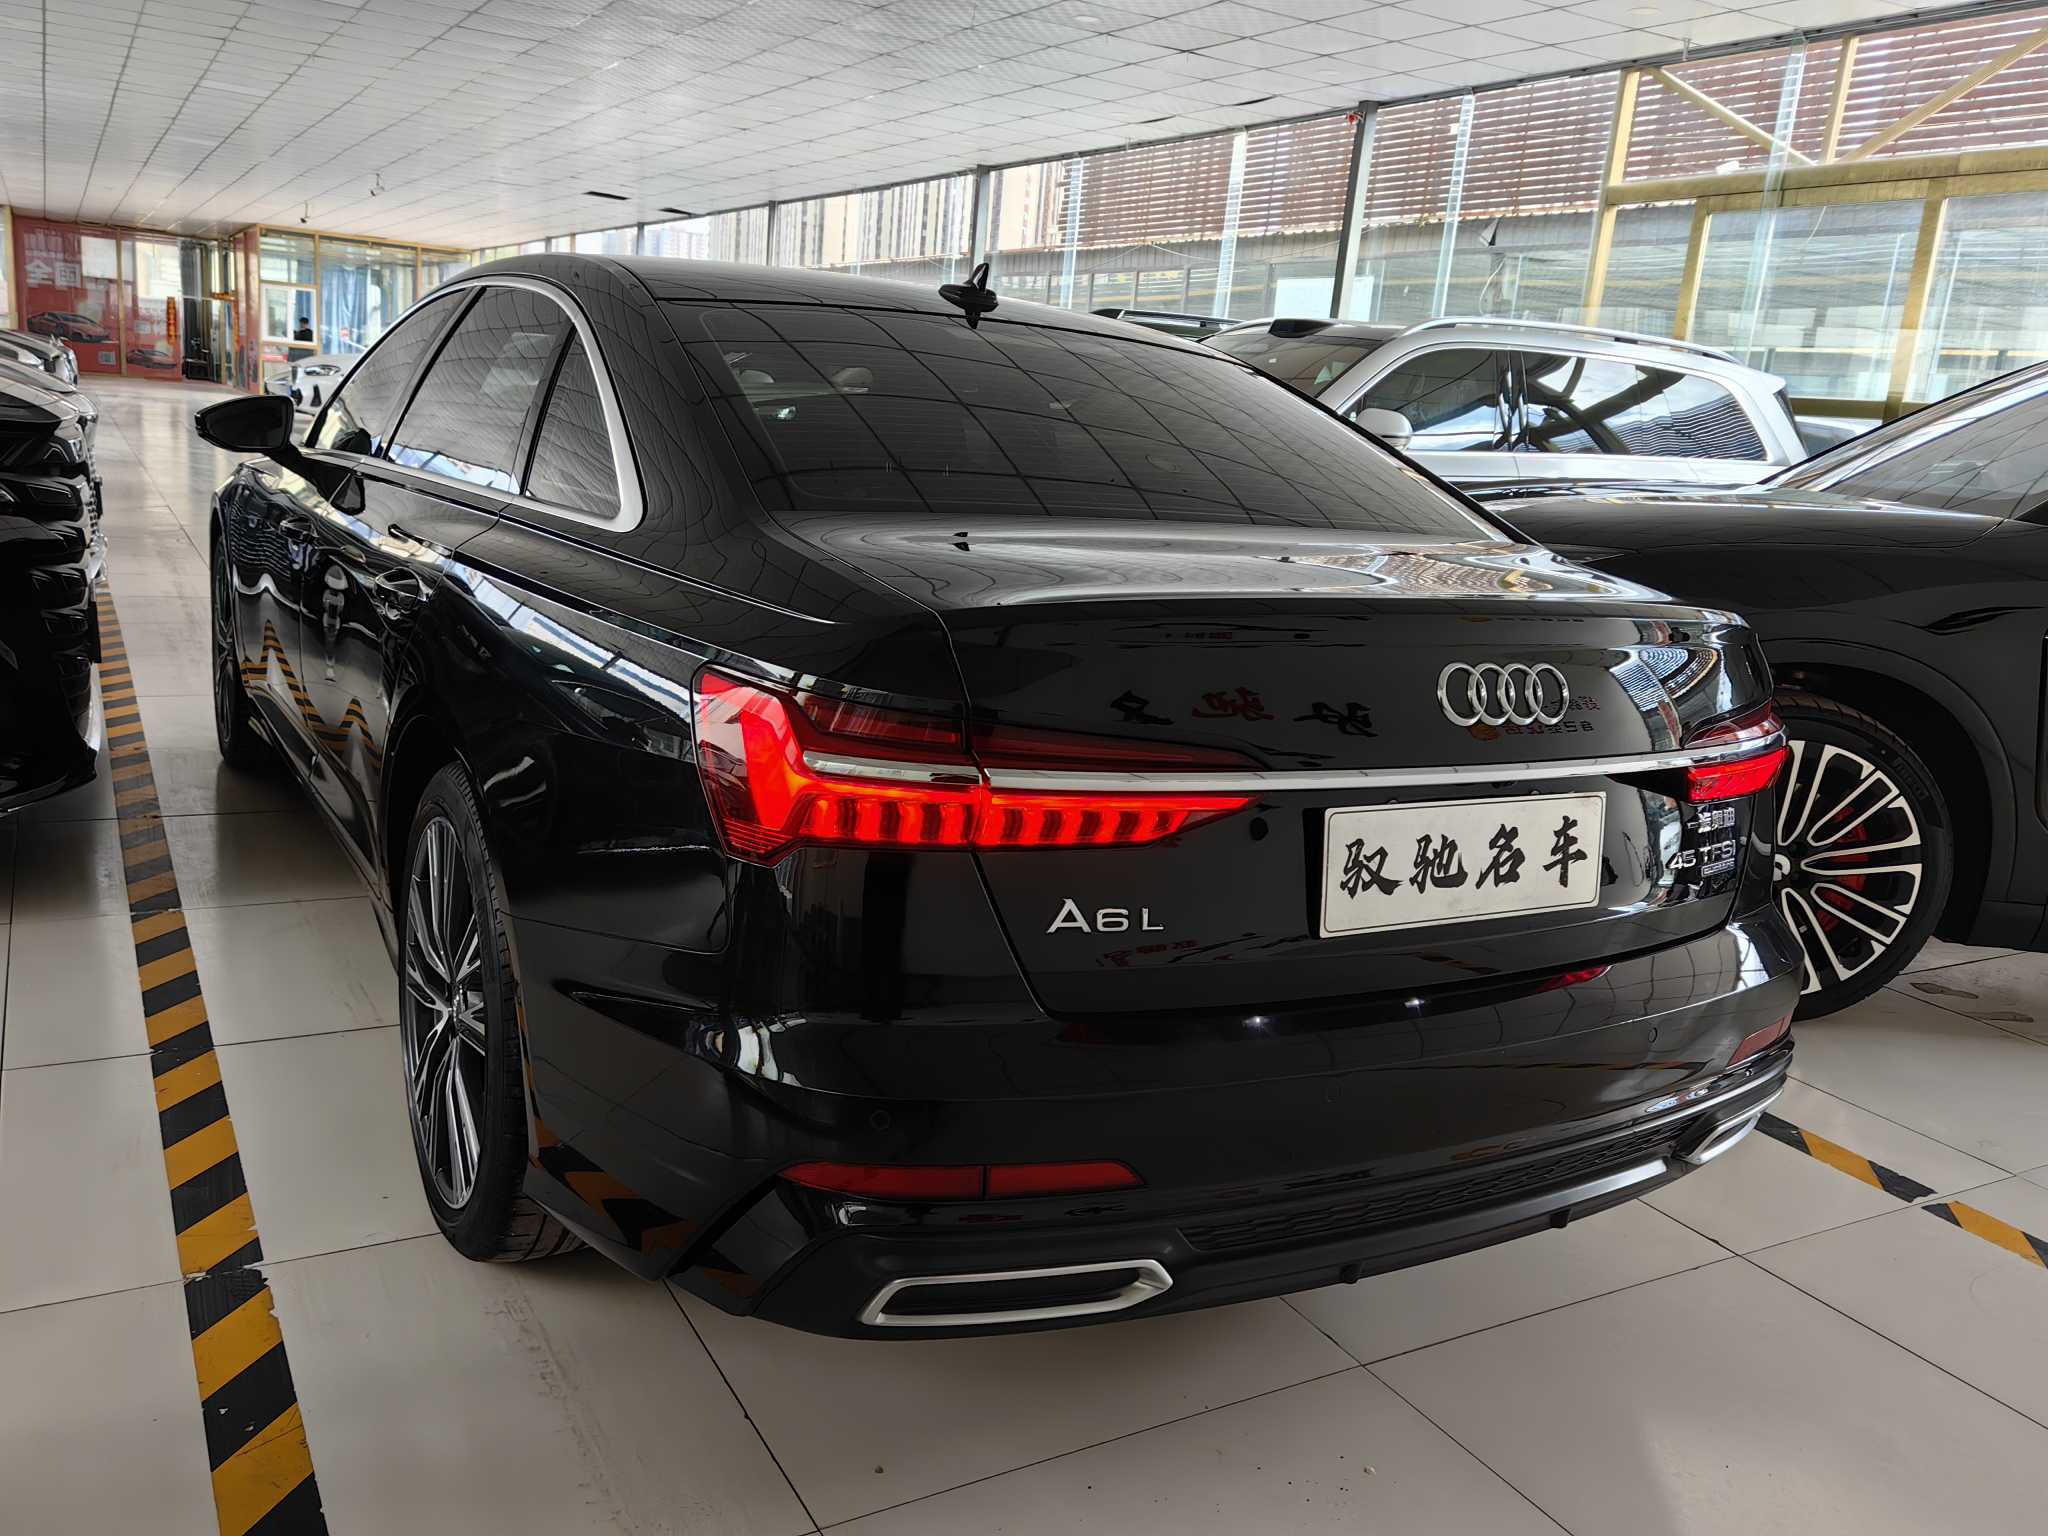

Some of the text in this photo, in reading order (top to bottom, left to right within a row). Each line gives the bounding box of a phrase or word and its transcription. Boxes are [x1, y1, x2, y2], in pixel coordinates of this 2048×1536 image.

[1340, 815, 1588, 900] 驭驰名车
[1669, 850, 1697, 869] 45
[1699, 839, 1736, 863] TFSI
